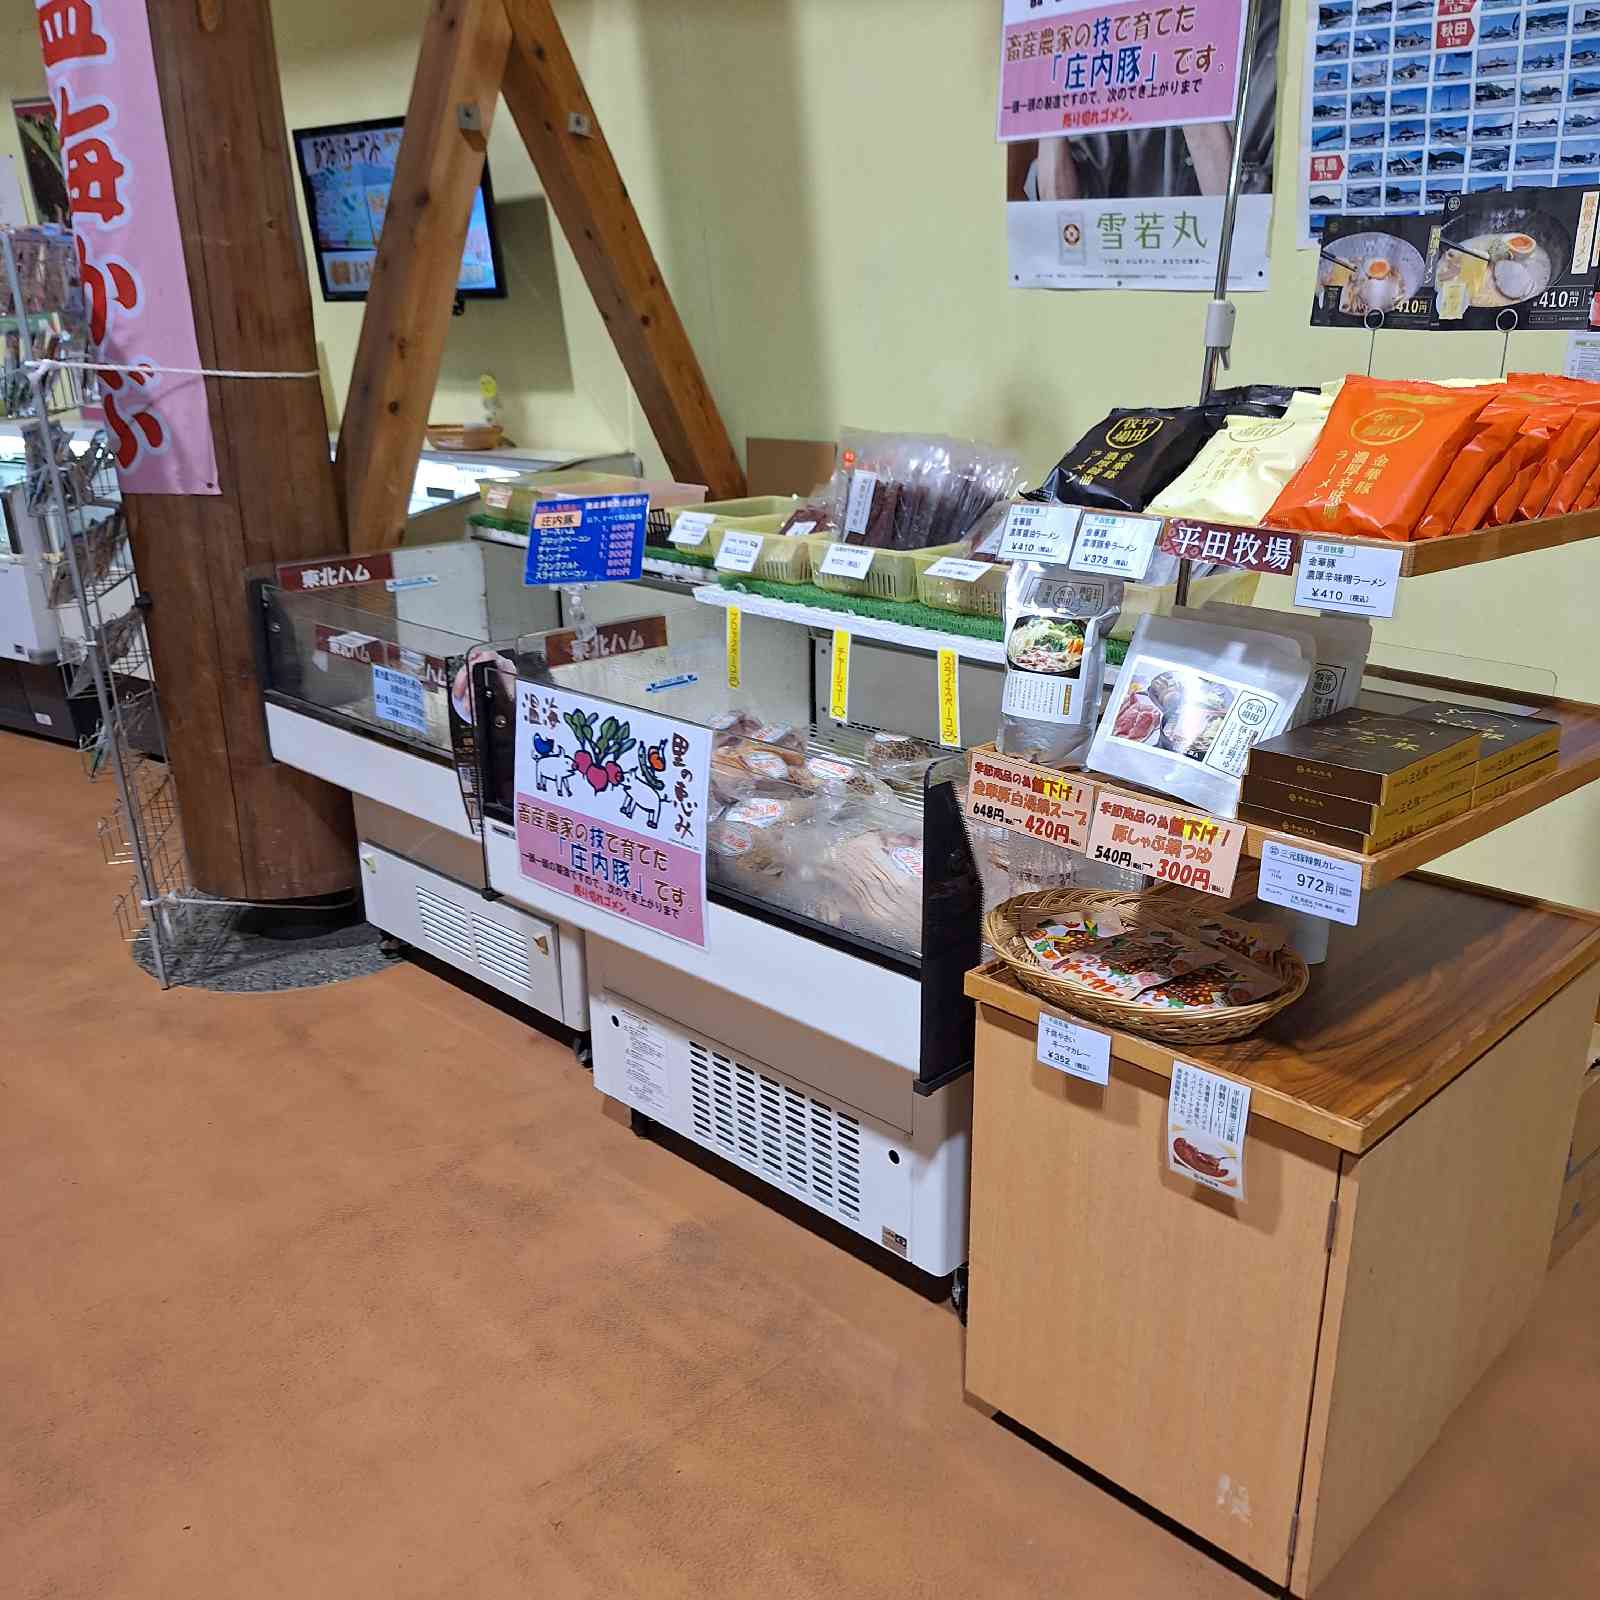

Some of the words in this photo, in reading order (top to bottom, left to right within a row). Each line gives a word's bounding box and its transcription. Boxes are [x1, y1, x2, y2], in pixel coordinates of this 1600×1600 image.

[1006, 4, 1196, 63] 畜産農家の技で育てた
[1096, 209, 1209, 250] 雪若丸
[1171, 526, 1293, 571] 平田牧場
[301, 563, 371, 589] 東北ハム
[1311, 587, 1344, 601] ¥410
[972, 802, 1005, 823] 648円
[517, 800, 668, 872] 畜産農家の技で育てた
[1024, 814, 1070, 844] 420円
[1094, 844, 1133, 868] 540円
[1156, 858, 1211, 891] 300円
